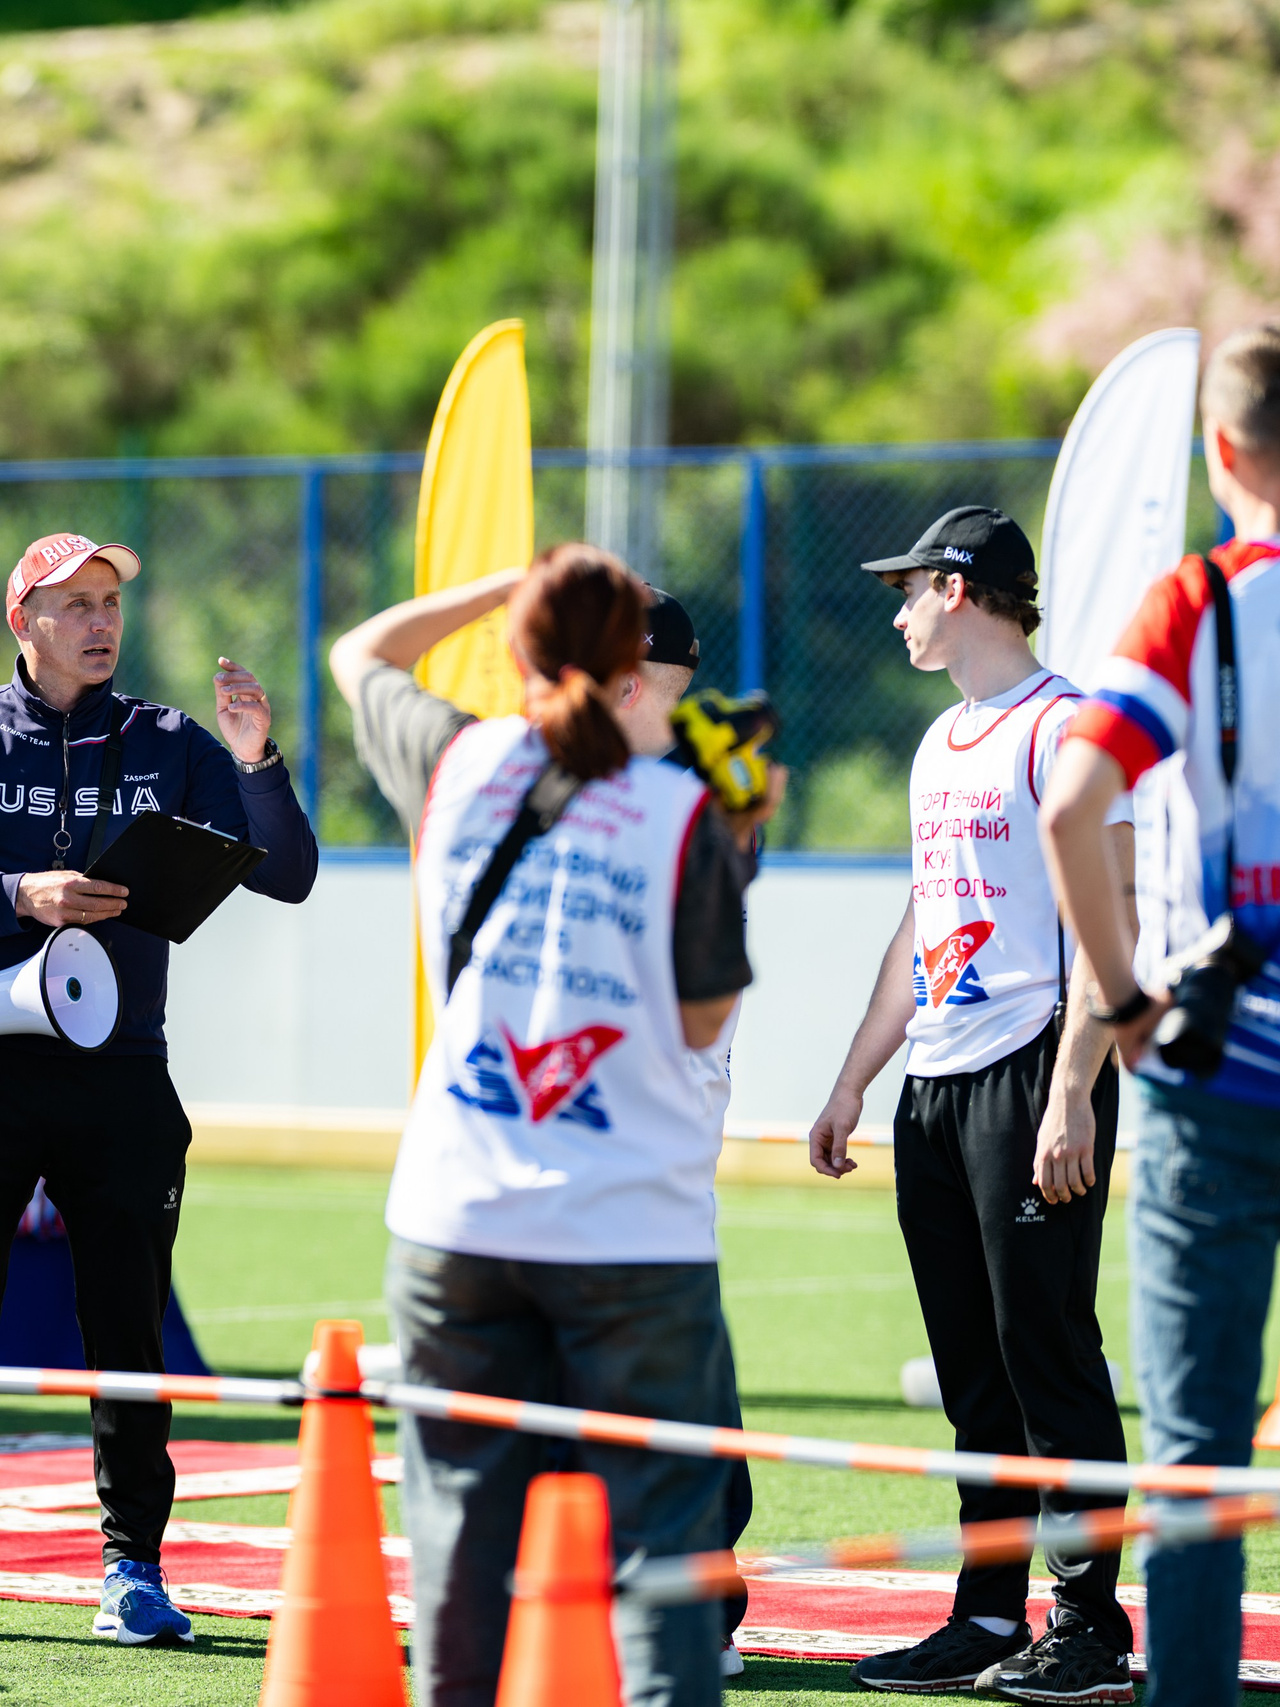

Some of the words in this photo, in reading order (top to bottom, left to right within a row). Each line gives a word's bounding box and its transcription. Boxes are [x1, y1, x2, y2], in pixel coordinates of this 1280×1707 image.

[944, 546, 974, 565] BMX
[0, 724, 28, 741] OLYMPIC
[29, 736, 50, 747] TEAM
[124, 772, 160, 783] ZASPORT
[1016, 1215, 1046, 1223] KELME
